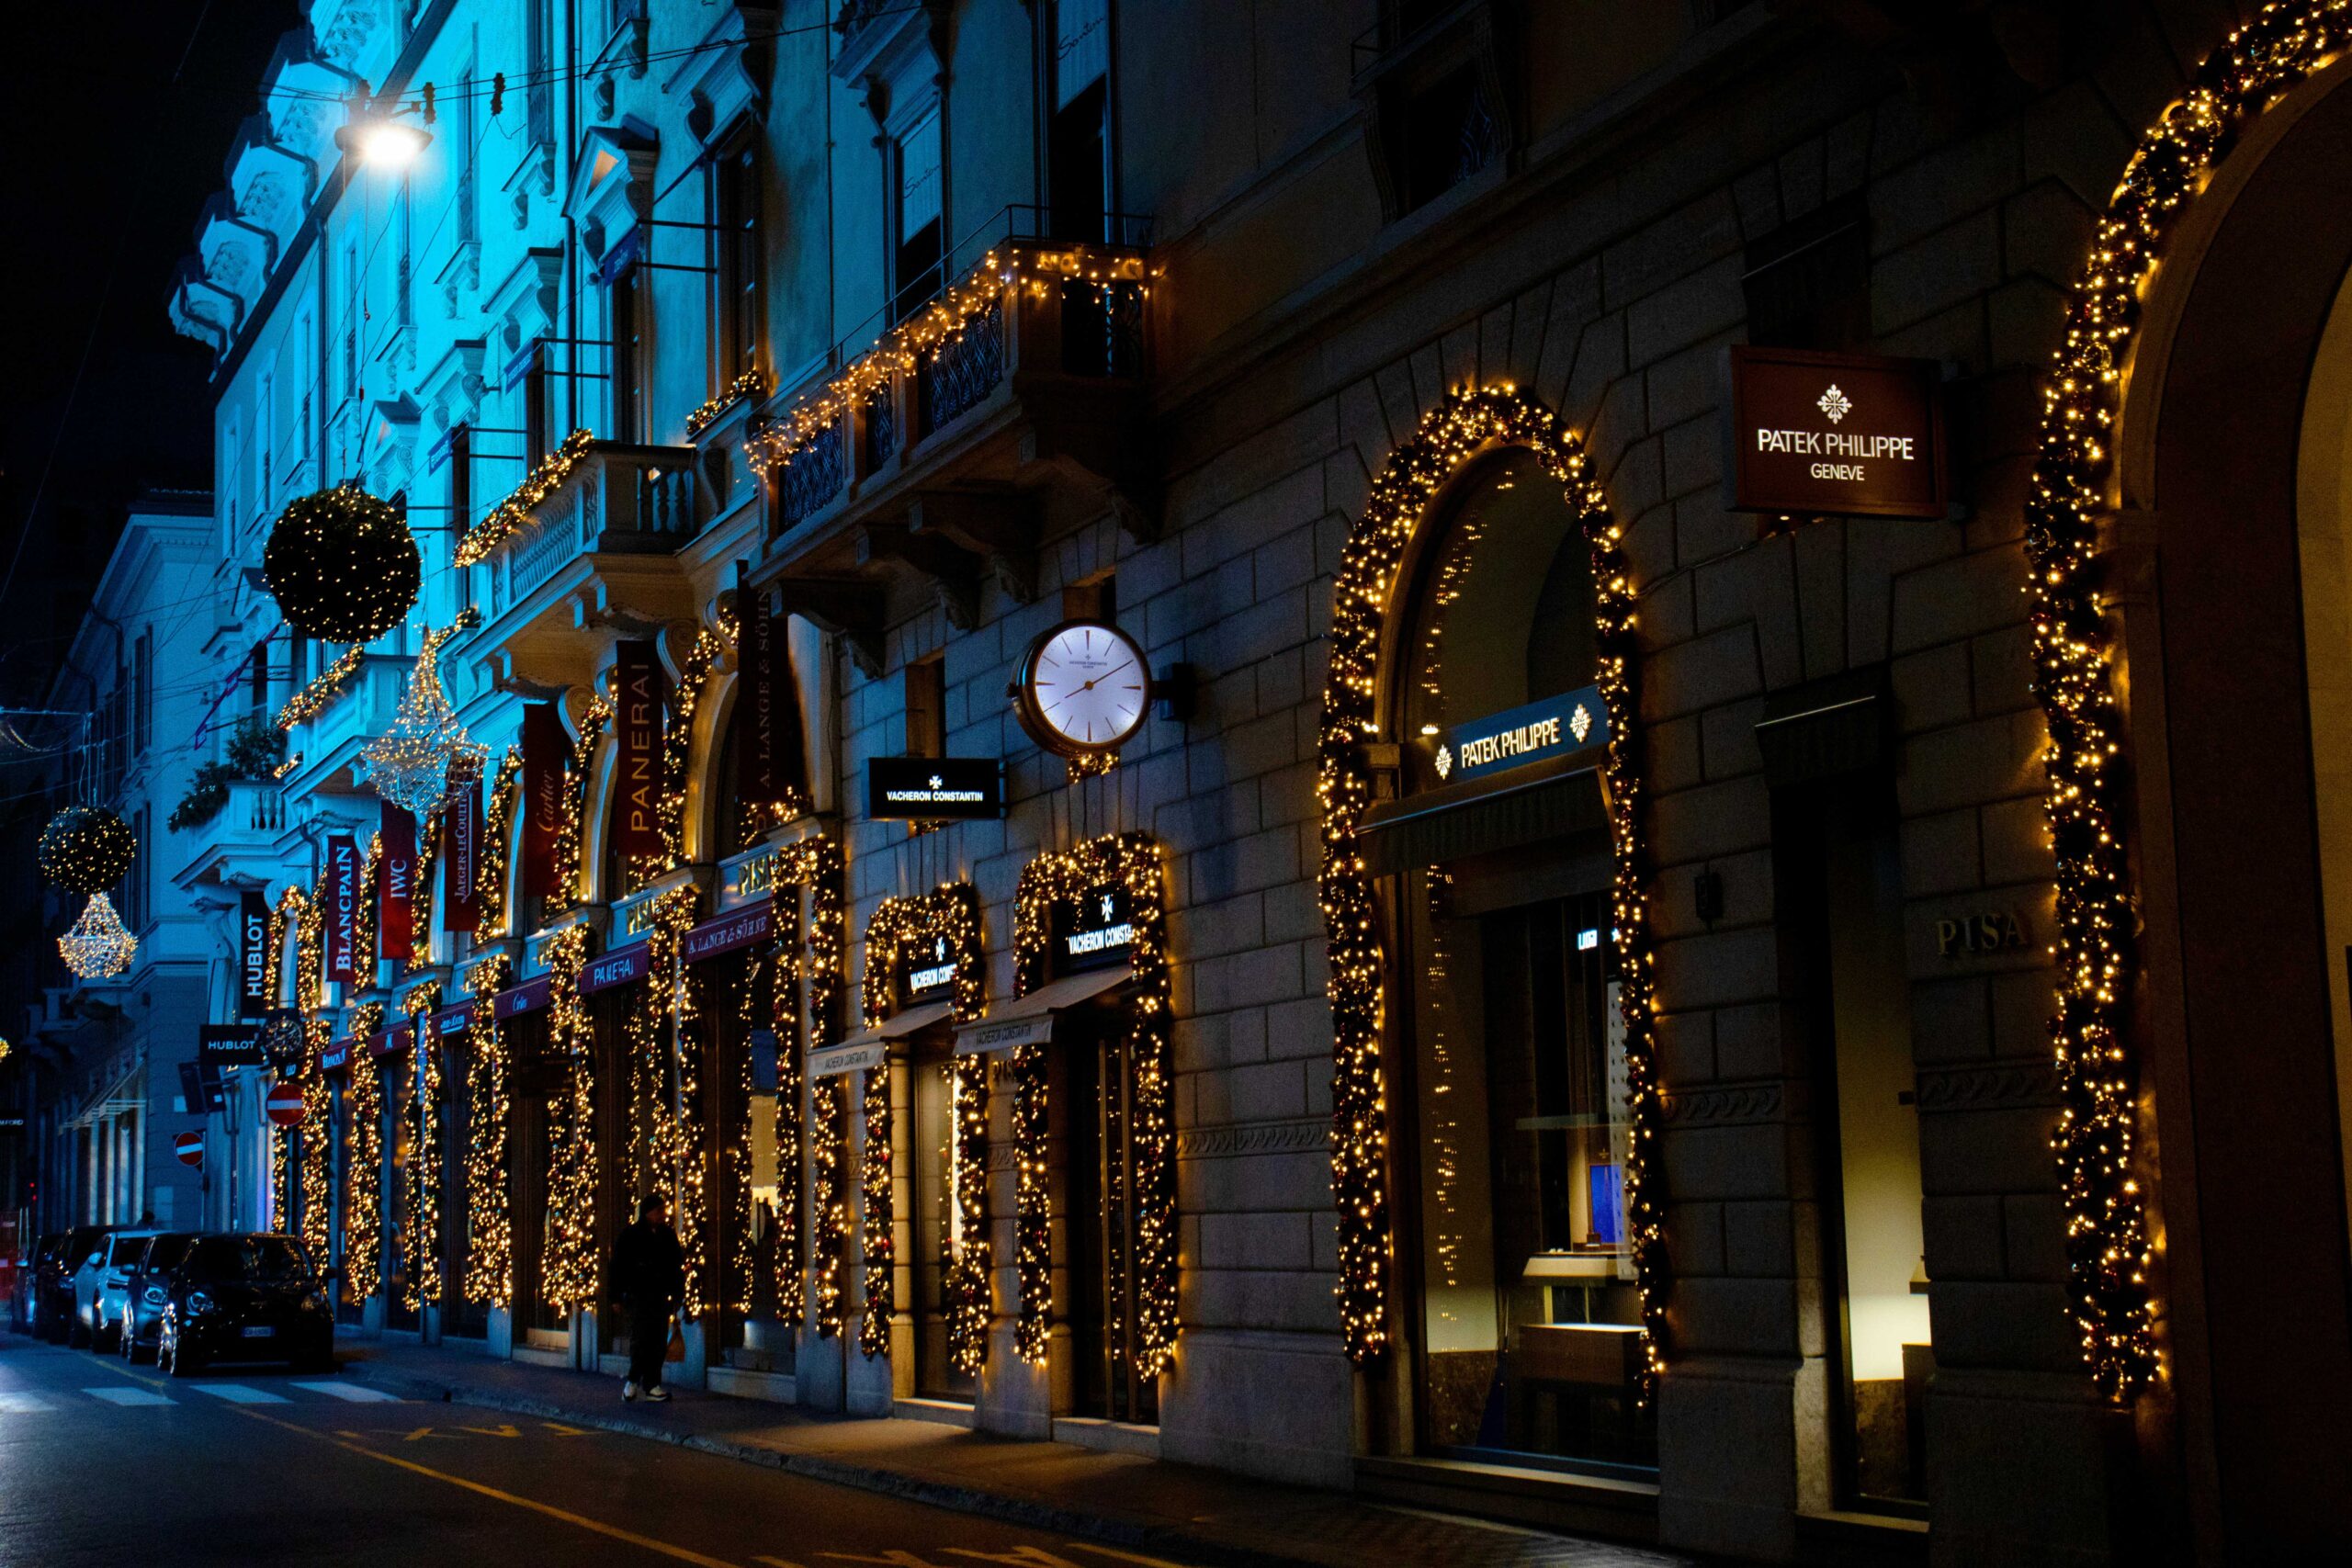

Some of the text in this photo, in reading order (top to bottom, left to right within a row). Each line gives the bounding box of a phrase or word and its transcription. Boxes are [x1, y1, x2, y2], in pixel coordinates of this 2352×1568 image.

[1757, 428, 1915, 460] PATEK PHILIPPE
[1810, 463, 1865, 481] GENEVE
[754, 588, 771, 651] SÖHN
[758, 657, 771, 675] &
[757, 681, 771, 761] LANGE
[630, 664, 650, 832] PANERAI
[1461, 716, 1561, 769] PATEK PHILIPPE
[536, 769, 555, 832] Cartier
[886, 790, 983, 802] VACHERON CONSTANTIN
[390, 859, 408, 898] IWC
[335, 844, 353, 972] BLANCPAIN
[698, 930, 727, 952] LANGE
[736, 916, 767, 940] SÖHNE
[1069, 930, 1104, 955] VACHERON
[1936, 910, 2027, 955] PISA
[246, 914, 265, 998] HUBLOT
[594, 957, 634, 986] PANERAI
[208, 1040, 255, 1051] HUBLOT
